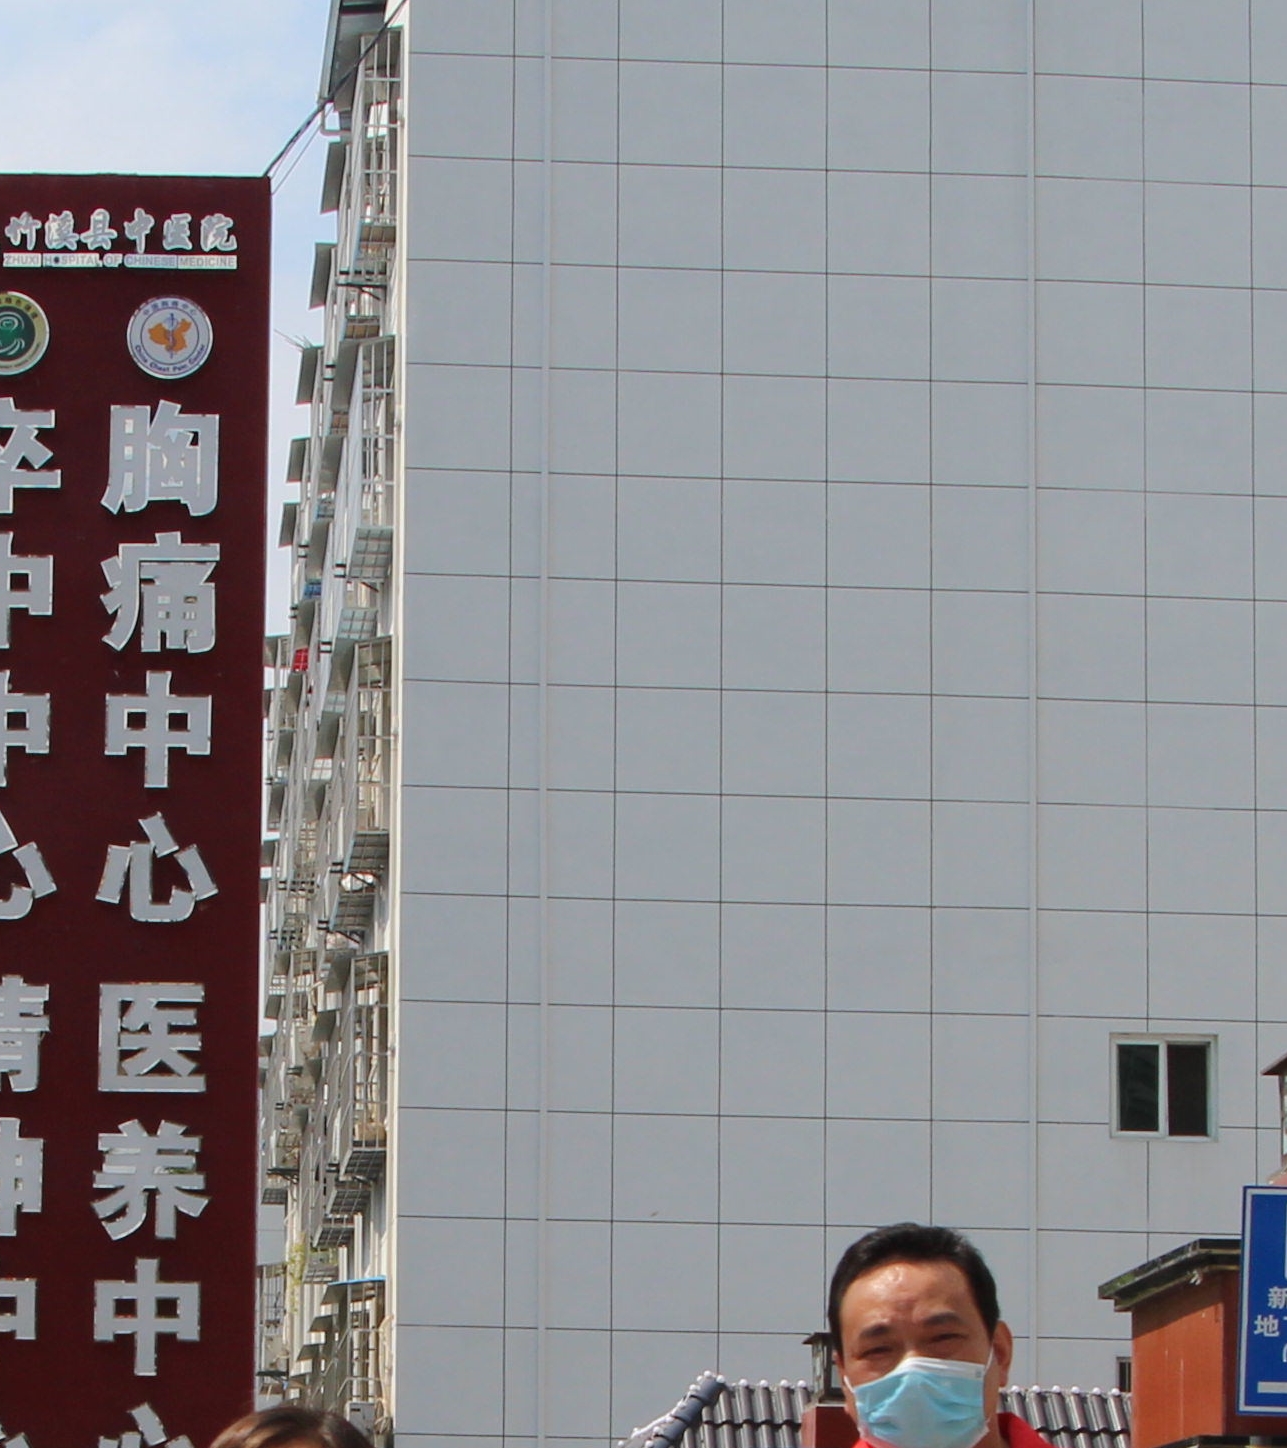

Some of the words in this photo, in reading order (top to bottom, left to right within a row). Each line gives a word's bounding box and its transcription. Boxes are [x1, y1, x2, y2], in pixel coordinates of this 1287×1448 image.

[5, 208, 237, 253] 竹溪县中医院
[4, 255, 40, 266] ZHUXI
[43, 255, 102, 267] HOSPITAL
[104, 256, 122, 267] OF
[125, 256, 177, 268] CHINESE
[179, 257, 236, 268] MEDICINE
